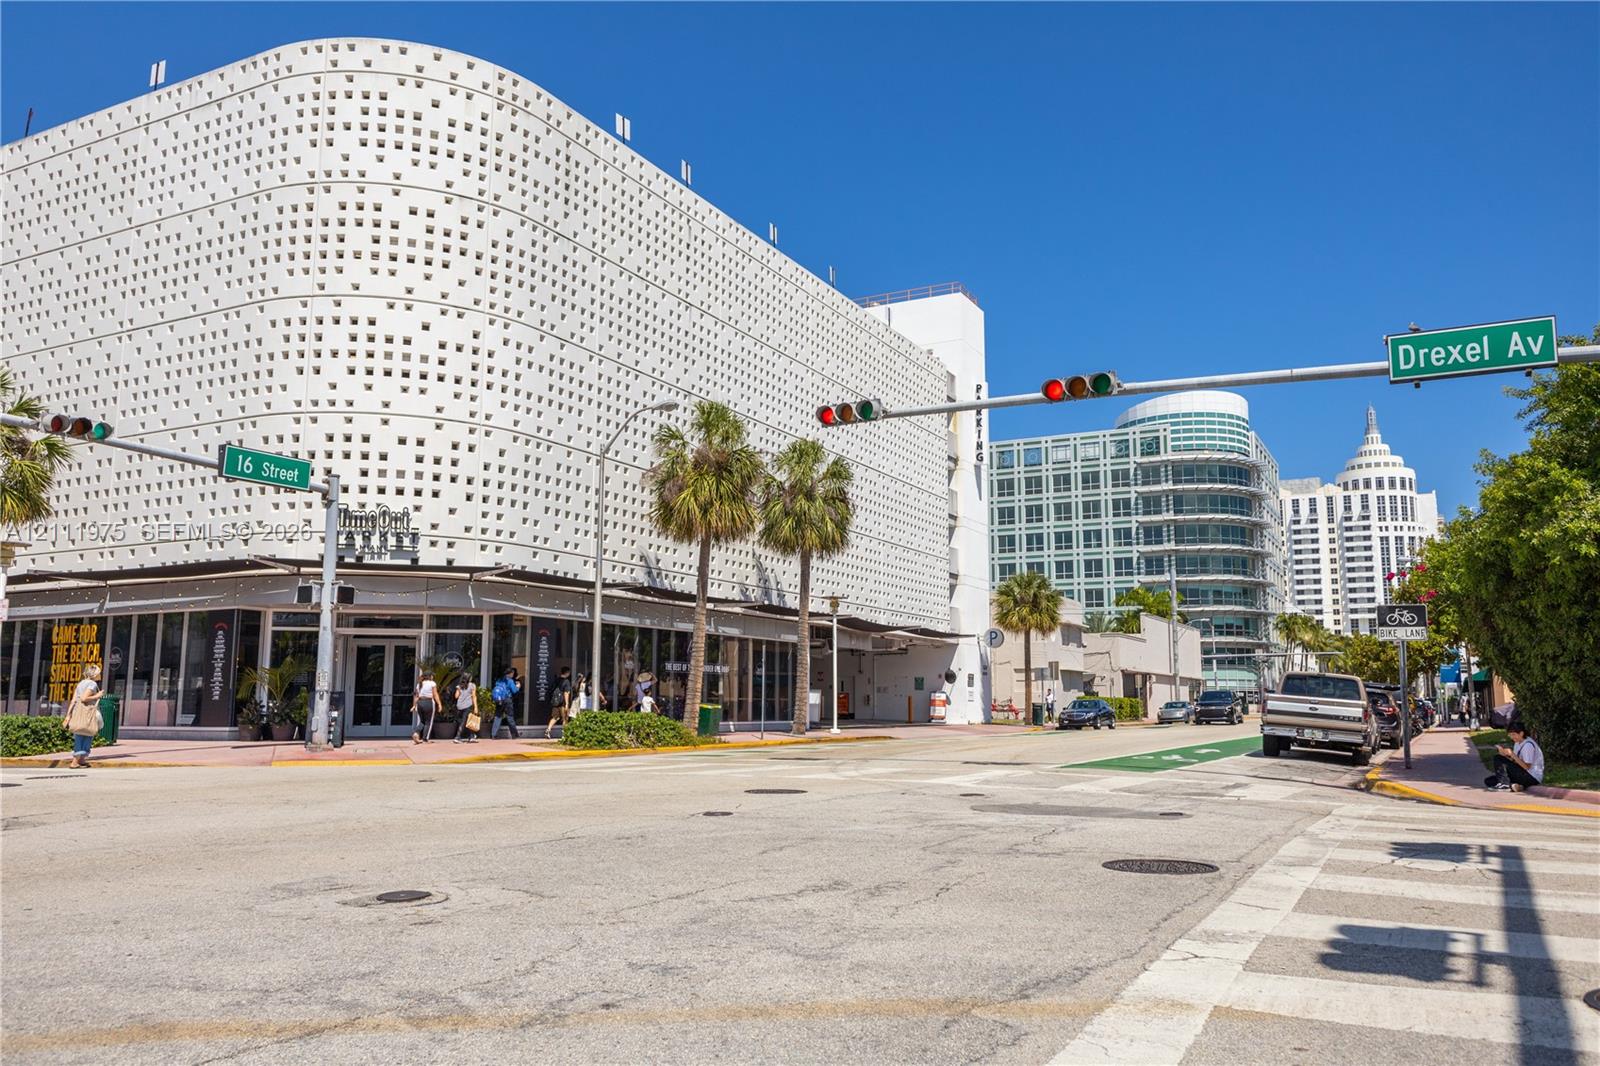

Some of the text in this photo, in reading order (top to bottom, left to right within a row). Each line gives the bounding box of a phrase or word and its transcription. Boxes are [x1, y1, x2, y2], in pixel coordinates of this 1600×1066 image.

[1398, 331, 1544, 370] Drexel Av
[237, 454, 299, 482] 16 Street
[52, 624, 98, 644] CAME FOR
[989, 631, 998, 646] P
[1380, 629, 1426, 638] BIKE LANE
[52, 645, 69, 665] THE
[50, 663, 82, 682] STAYED
[49, 683, 66, 702] THE
